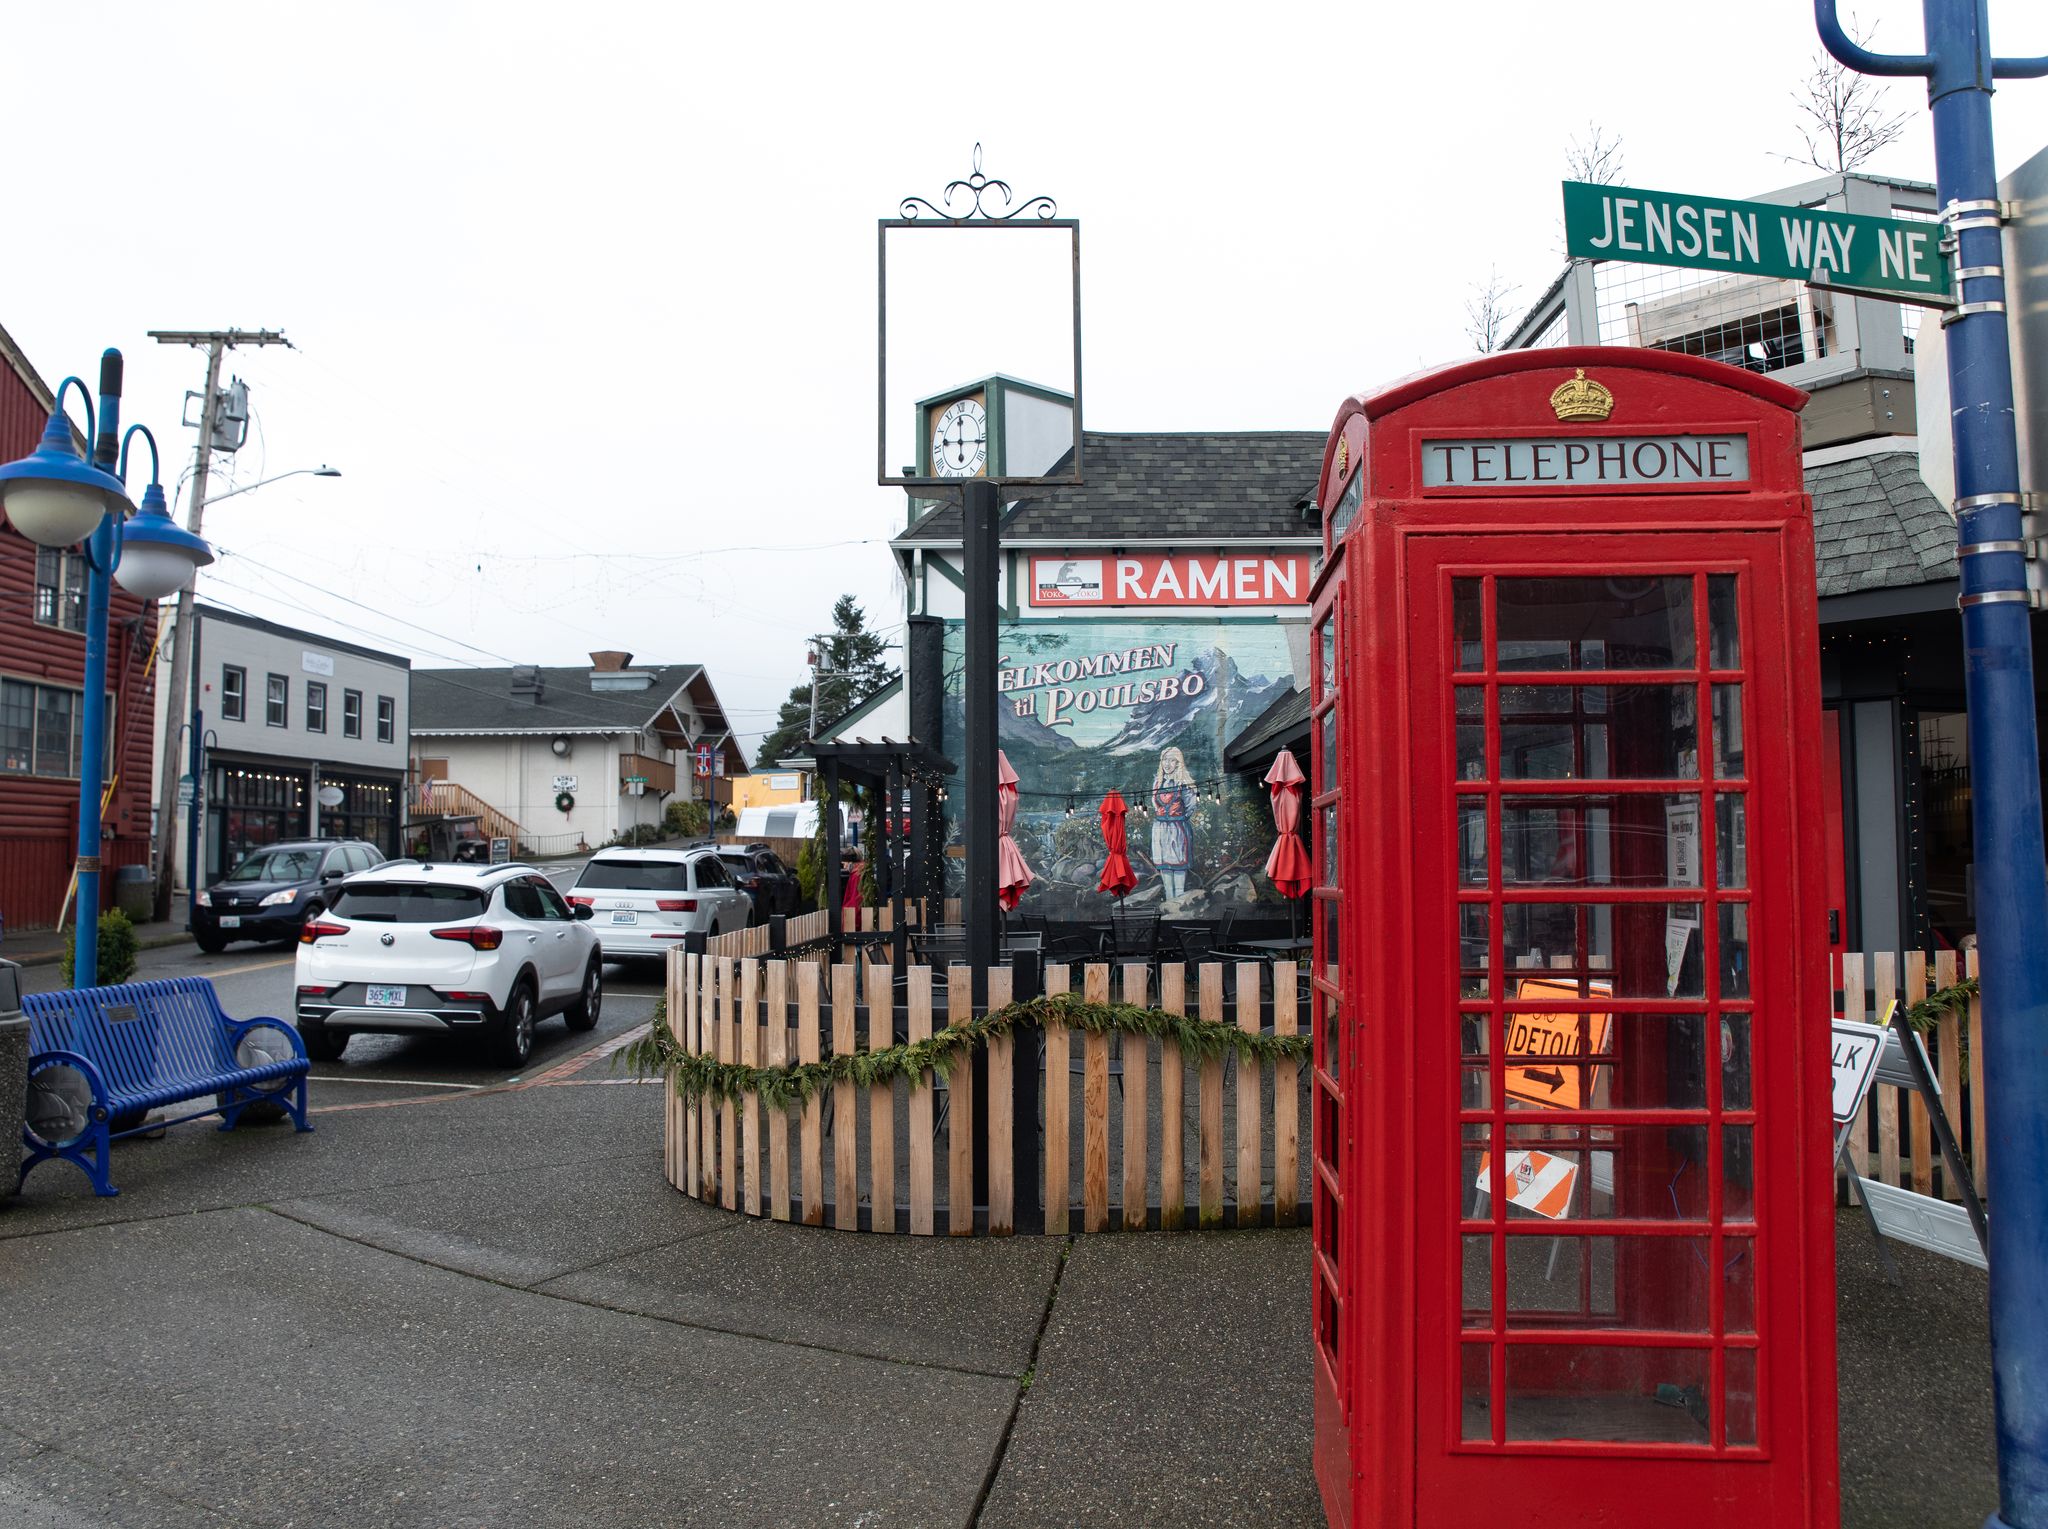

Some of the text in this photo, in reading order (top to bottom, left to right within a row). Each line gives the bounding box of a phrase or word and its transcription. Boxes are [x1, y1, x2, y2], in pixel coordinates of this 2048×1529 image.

[1589, 196, 1931, 283] JENSEN WAY NE
[1432, 441, 1733, 483] TELEPHONE
[1041, 590, 1064, 598] YOKO
[1116, 559, 1297, 600] RAMEN
[998, 642, 1178, 692] ELKOMMEN
[1013, 674, 1205, 728] til POULSBO
[368, 989, 384, 1001] 365
